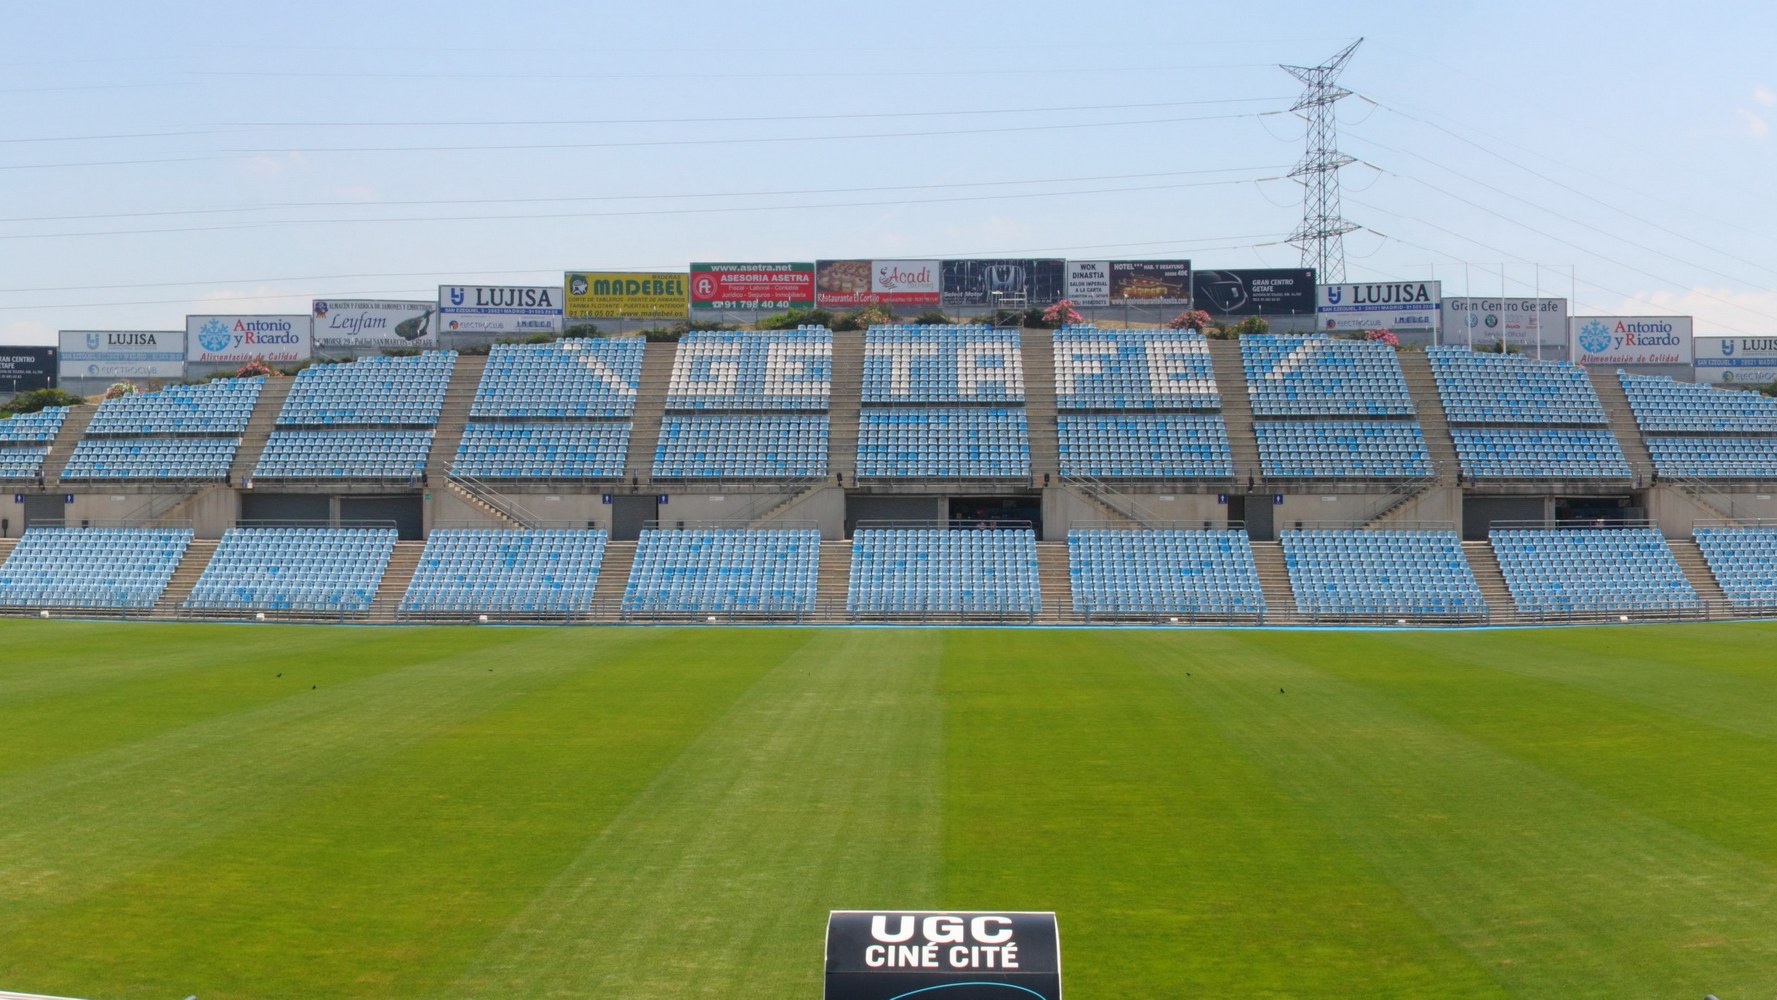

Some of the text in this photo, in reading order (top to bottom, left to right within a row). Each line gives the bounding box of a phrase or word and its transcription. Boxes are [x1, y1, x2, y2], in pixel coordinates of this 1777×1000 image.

[889, 266, 930, 284] Acadi
[594, 280, 684, 296] MADEBEL
[1353, 284, 1430, 304] LUJISA
[476, 288, 552, 306] LUJISA
[818, 294, 853, 302] Restaurante
[1482, 300, 1518, 312] Cenro
[234, 319, 292, 332] Antonio
[329, 312, 388, 336] Leyfam
[1614, 320, 1672, 333] Antonio
[108, 334, 156, 345] LUJISA
[234, 332, 300, 348] y Ricardo
[1615, 334, 1680, 349] y Ricardo
[268, 352, 298, 360] Calidad
[1637, 354, 1646, 362] de
[1650, 354, 1680, 362] Calidad
[871, 916, 1013, 944] UGC
[865, 942, 1019, 968] CINÉ CITÉ
